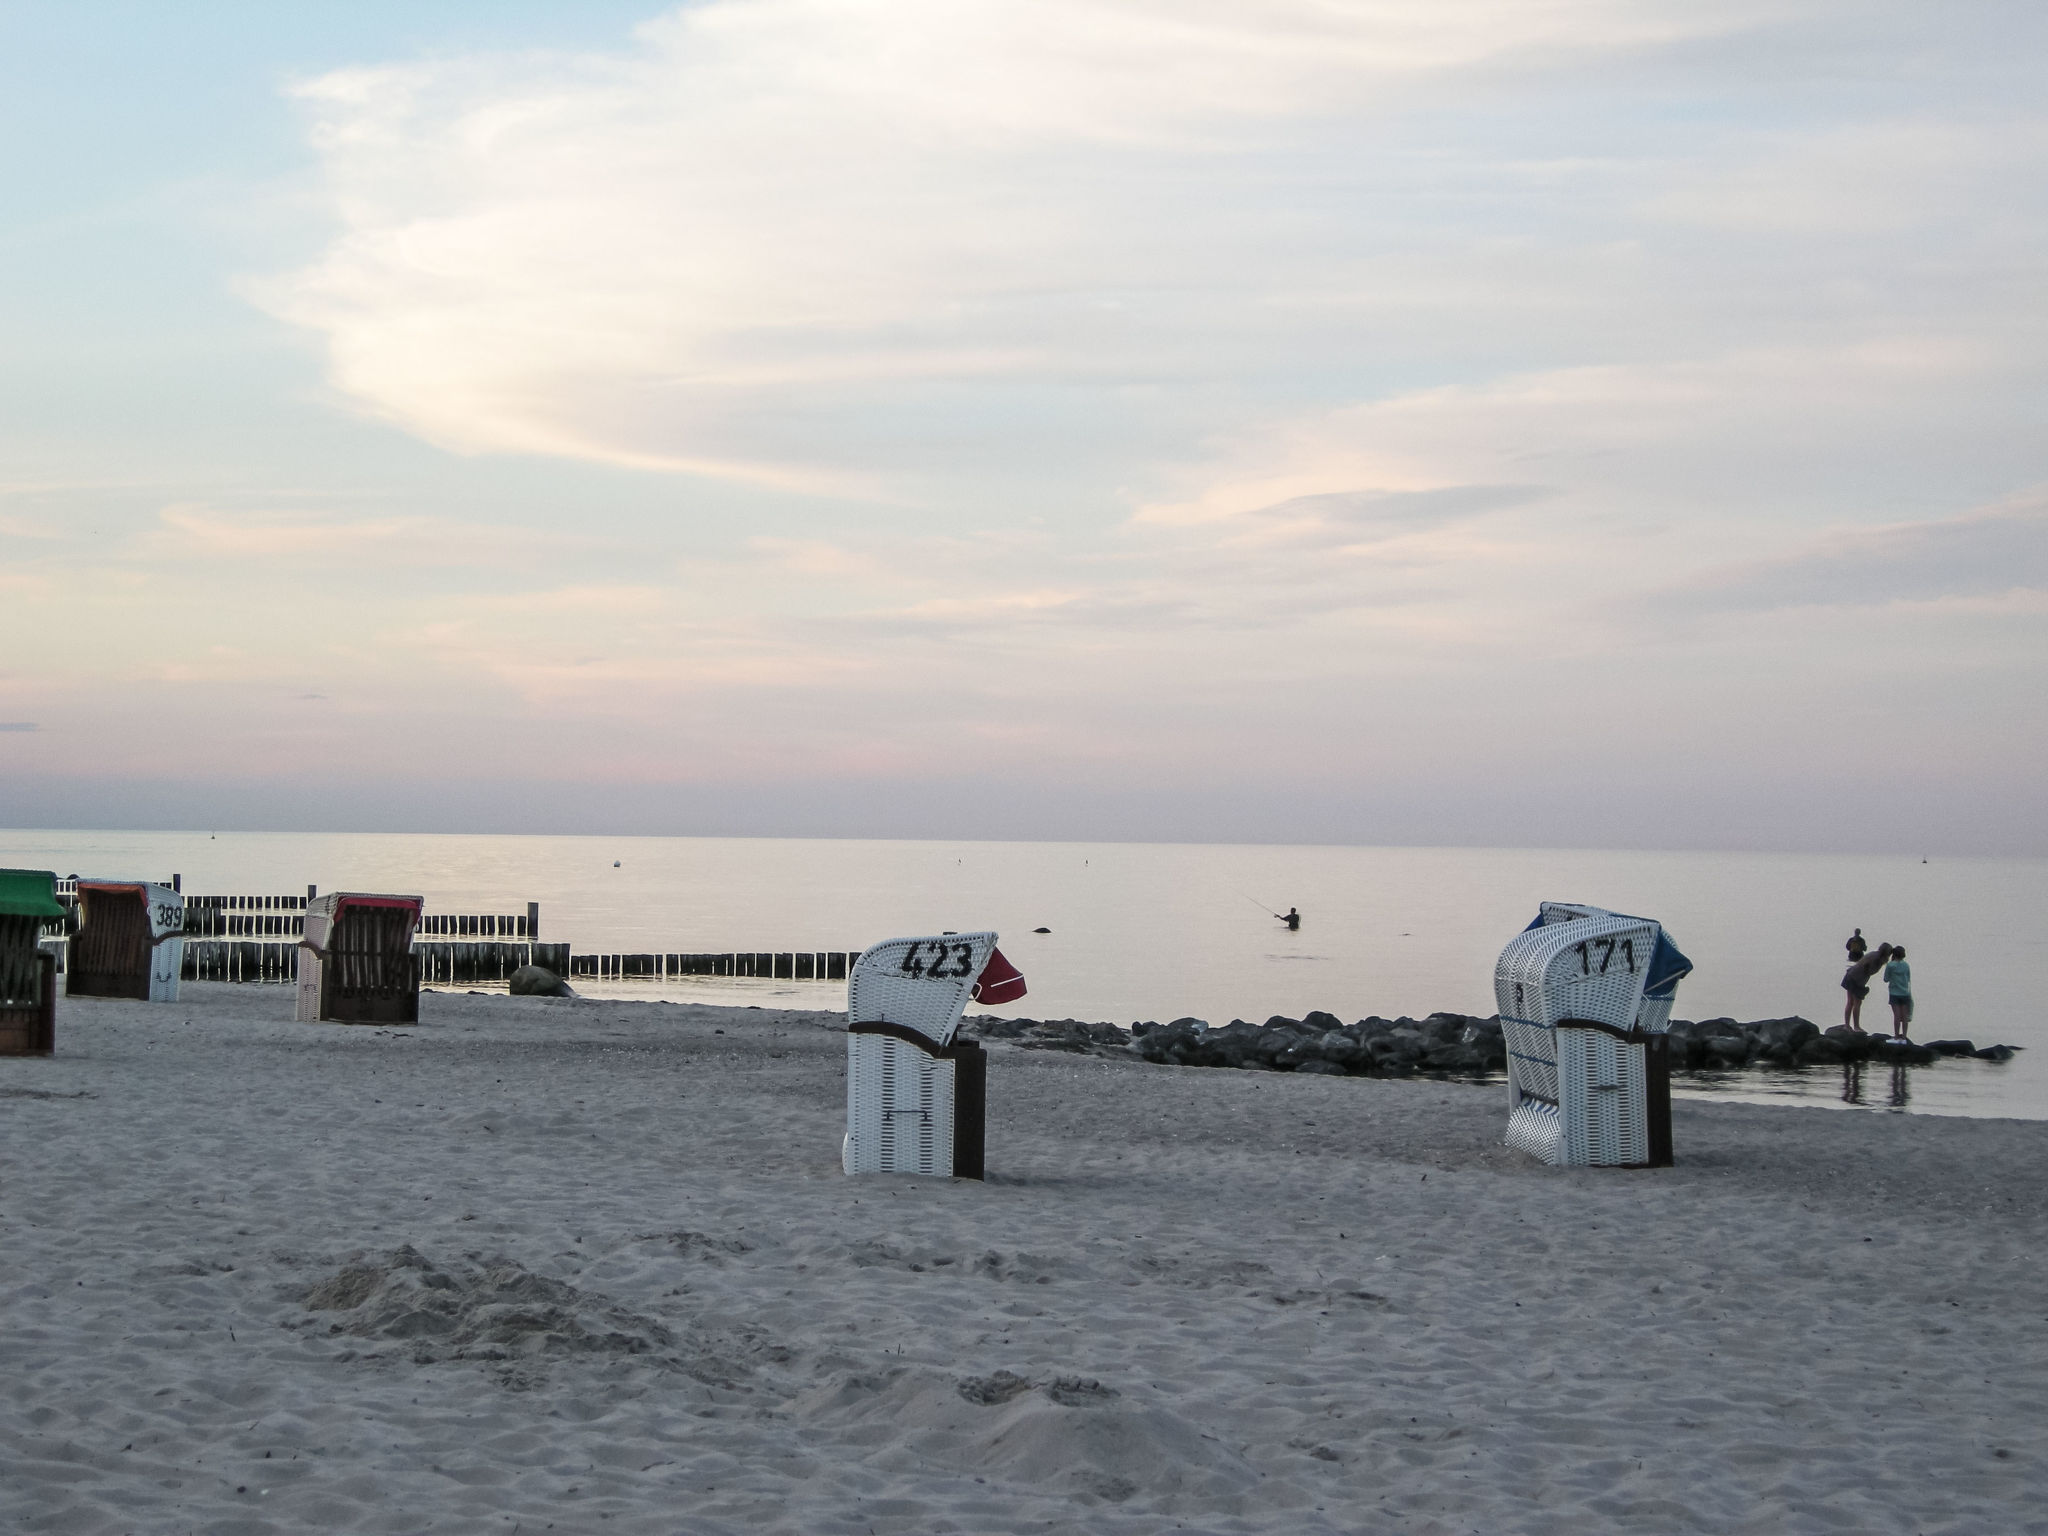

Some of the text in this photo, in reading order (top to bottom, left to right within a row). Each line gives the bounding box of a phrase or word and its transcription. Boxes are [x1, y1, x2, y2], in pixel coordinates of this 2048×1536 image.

[157, 904, 182, 927] 389
[902, 941, 973, 980] 423
[1575, 938, 1634, 975] 171
